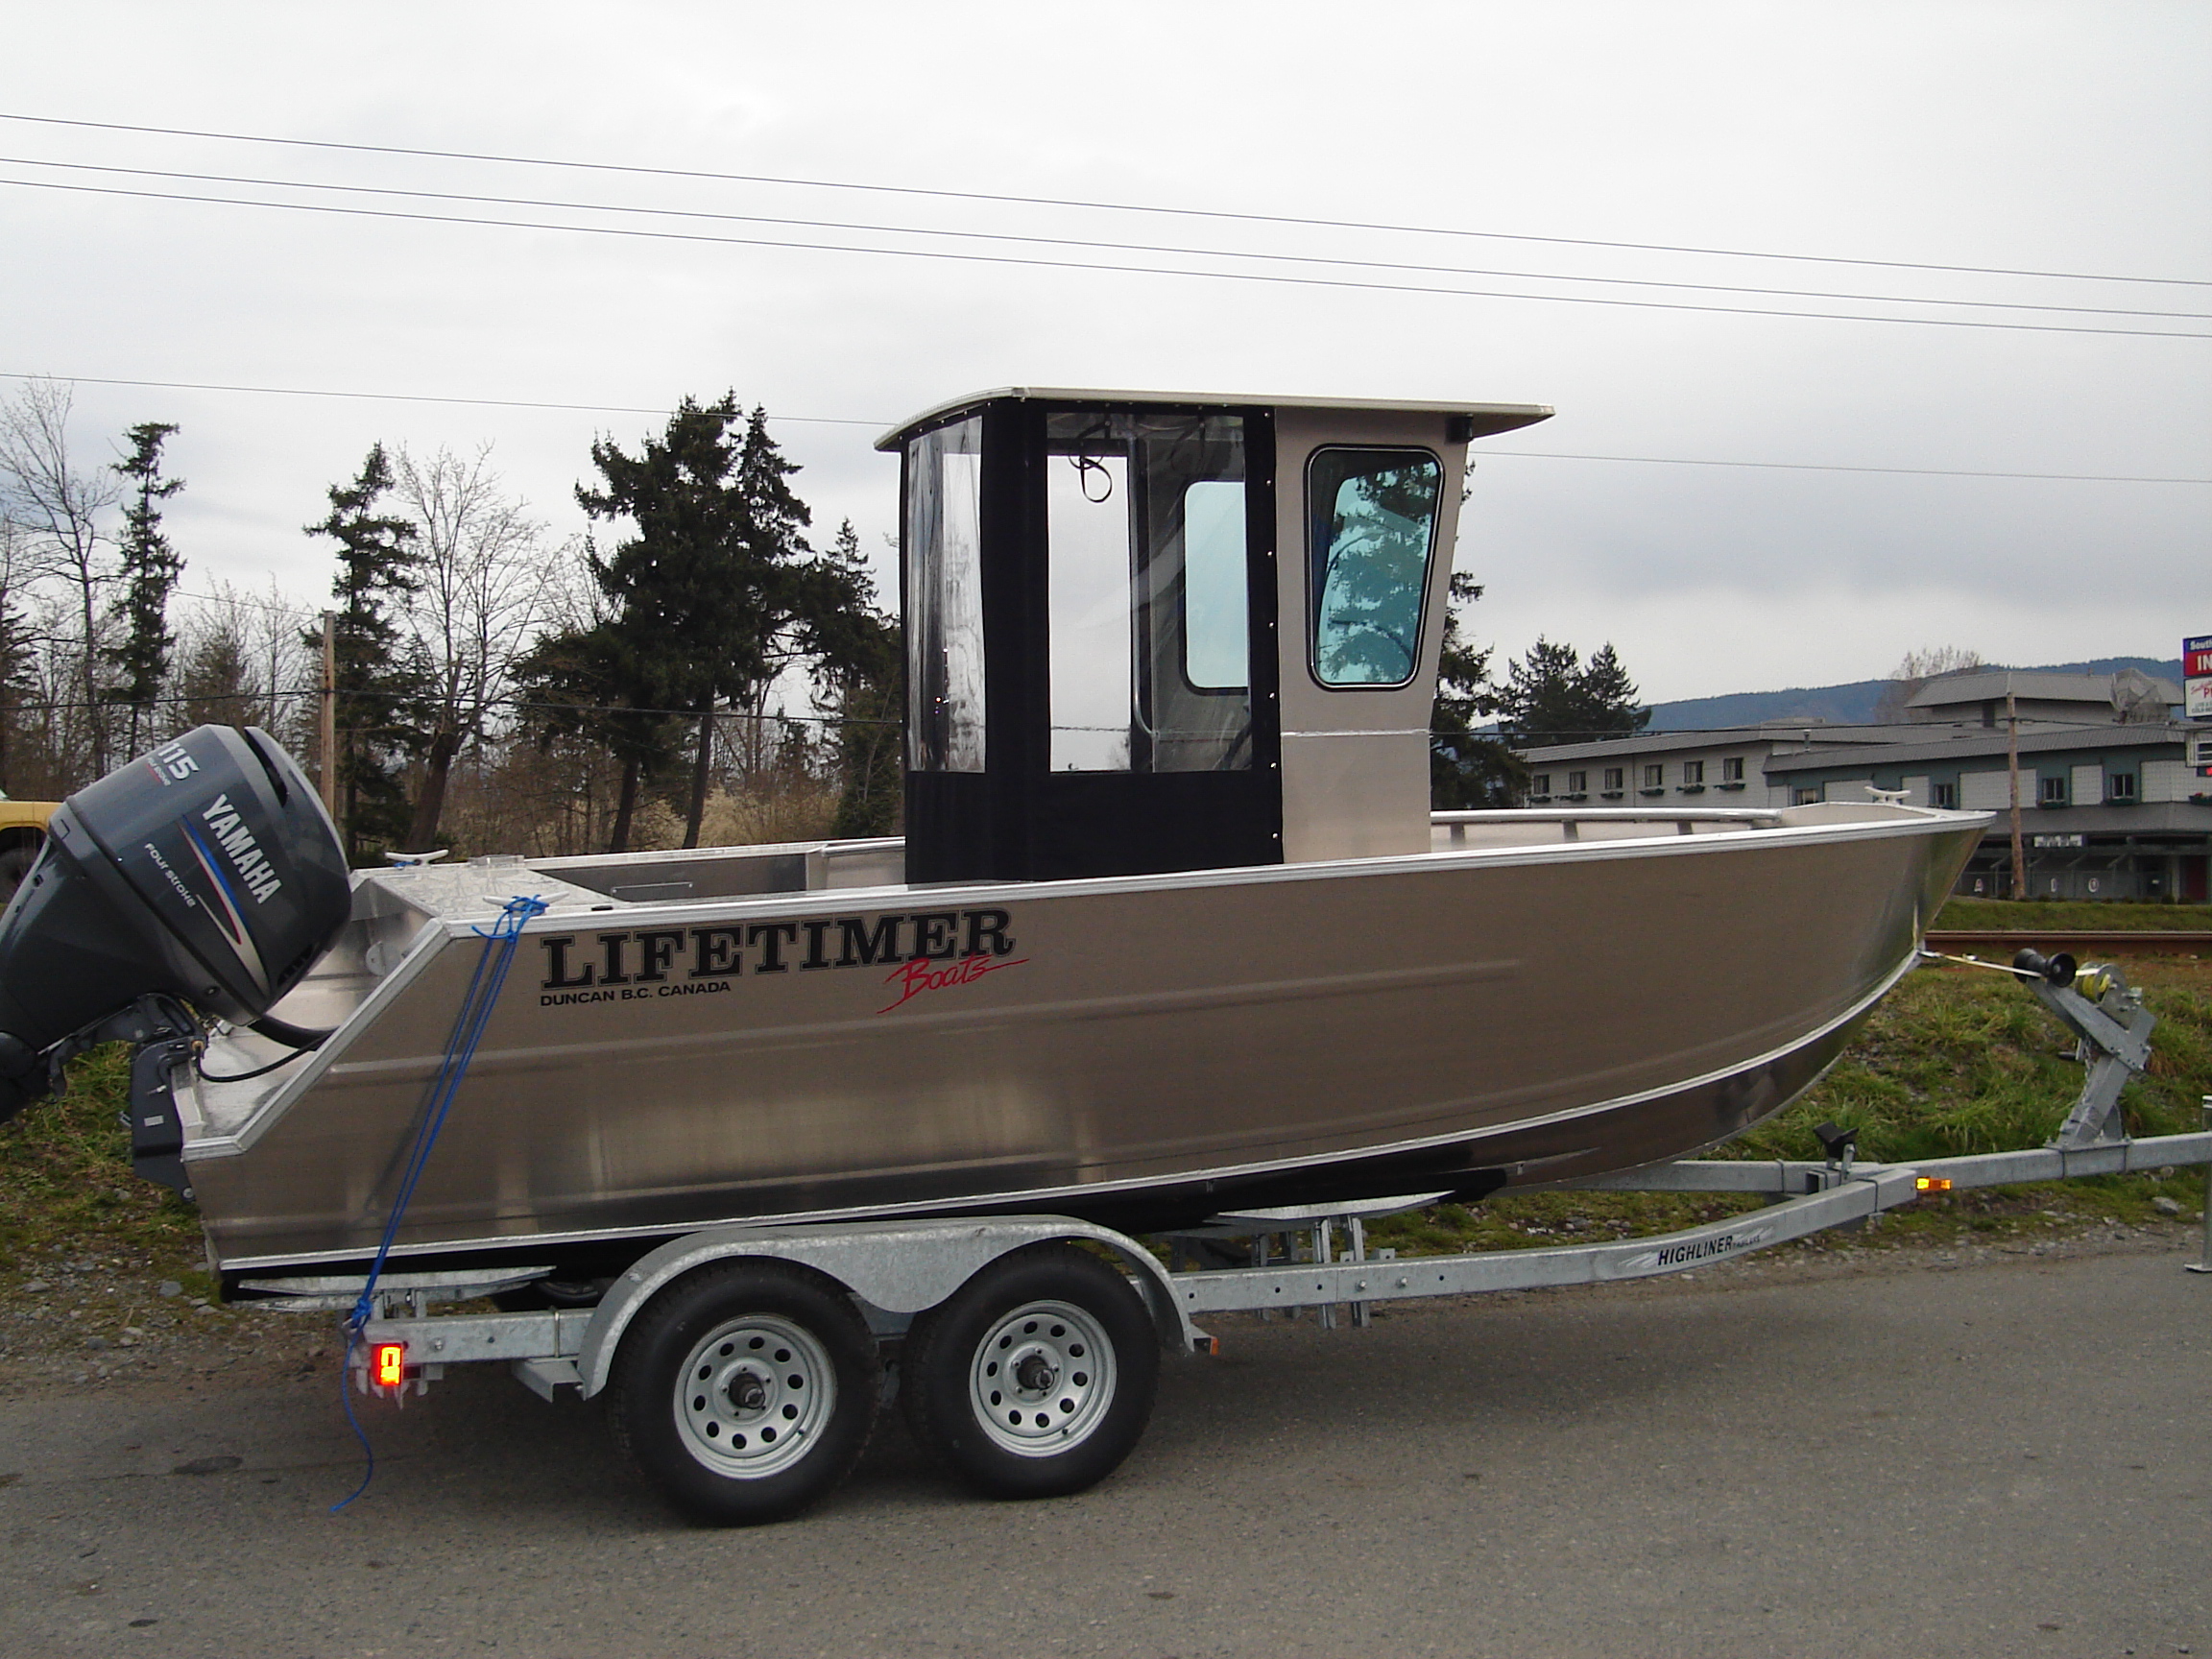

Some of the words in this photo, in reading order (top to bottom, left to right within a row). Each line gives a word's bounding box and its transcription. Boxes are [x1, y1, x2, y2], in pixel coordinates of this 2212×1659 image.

[158, 742, 200, 780] 115
[203, 793, 281, 904] YAMAHA
[541, 907, 1017, 992] LIFETIMER
[541, 991, 614, 1006] DUNCAN
[621, 988, 653, 1000] B.C.
[658, 981, 731, 997] CANADA
[877, 951, 1030, 1014] Boats
[1657, 1235, 1733, 1265] HIGHLINER
